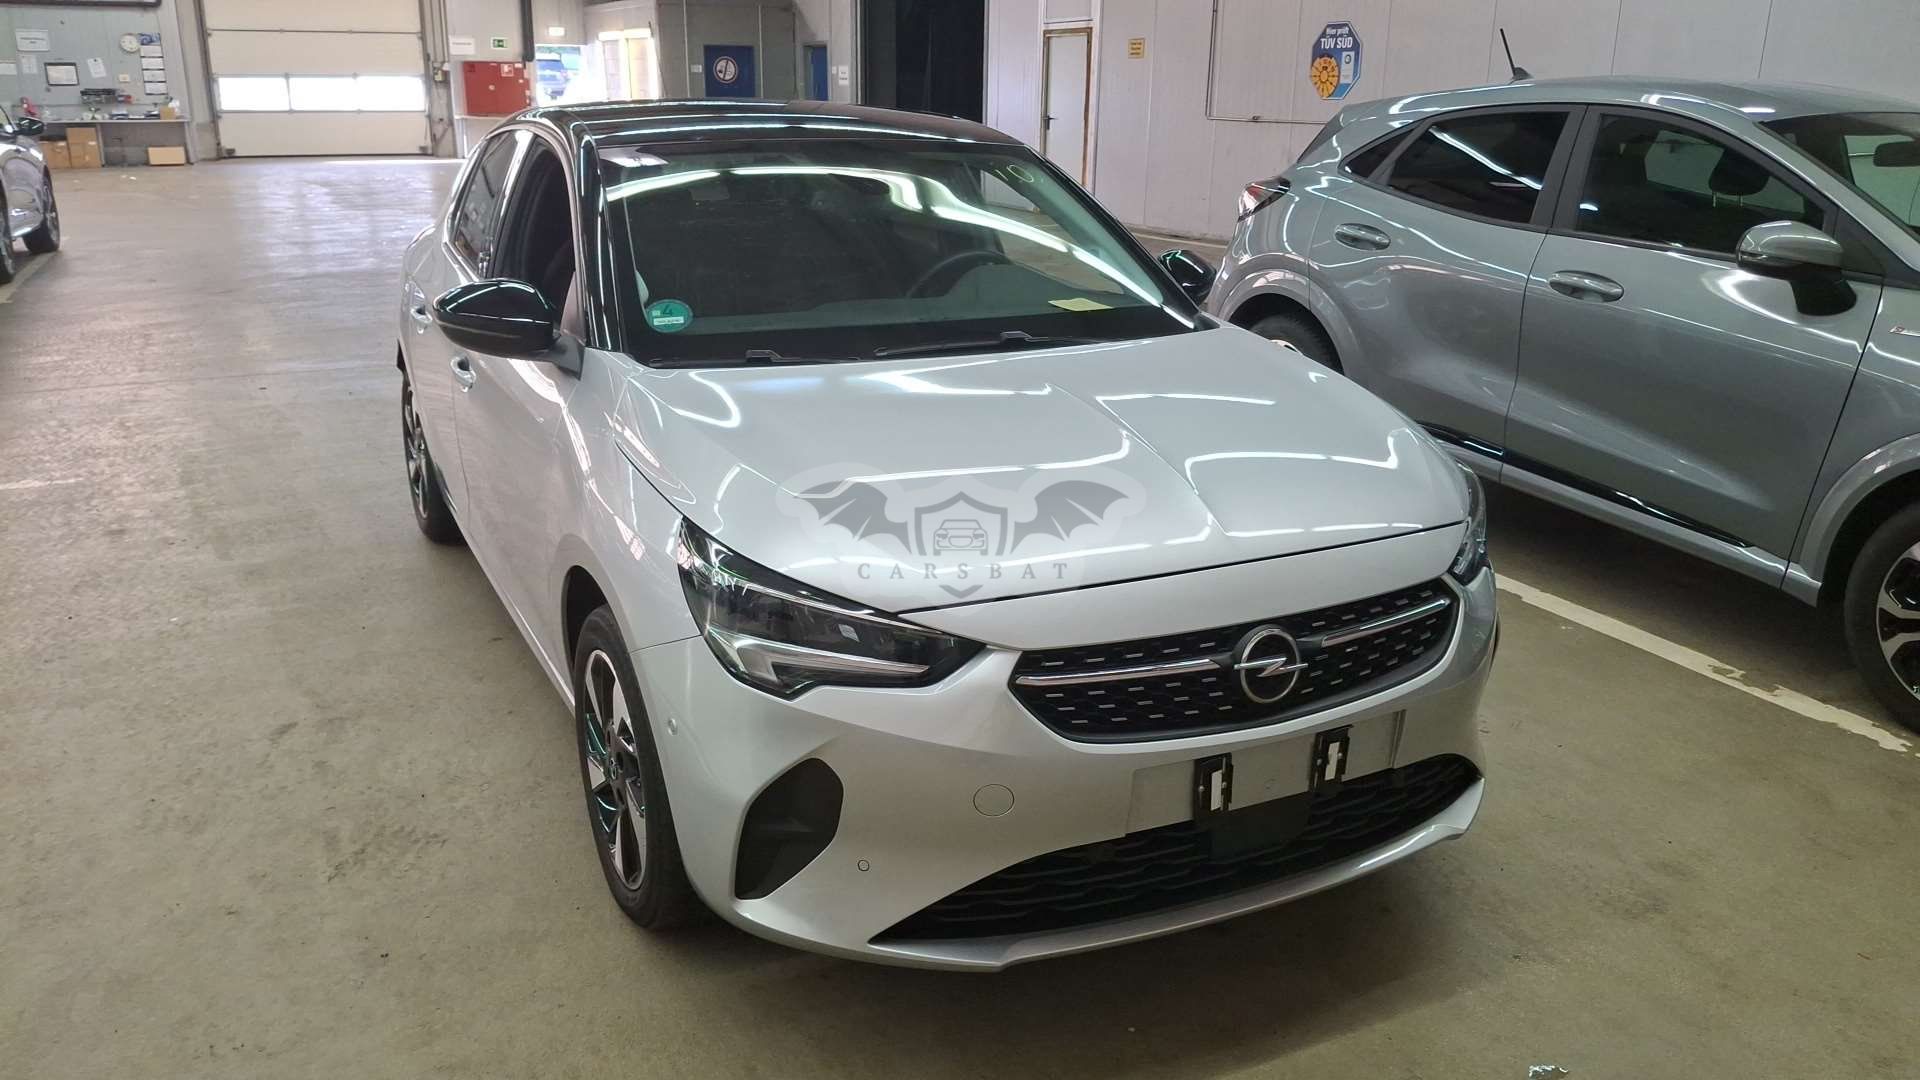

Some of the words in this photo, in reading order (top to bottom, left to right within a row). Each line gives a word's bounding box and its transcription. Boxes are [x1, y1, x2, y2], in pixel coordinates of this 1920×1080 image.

[1320, 35, 1336, 49] TÜV
[1336, 34, 1353, 49] SÜD
[663, 304, 673, 316] 4
